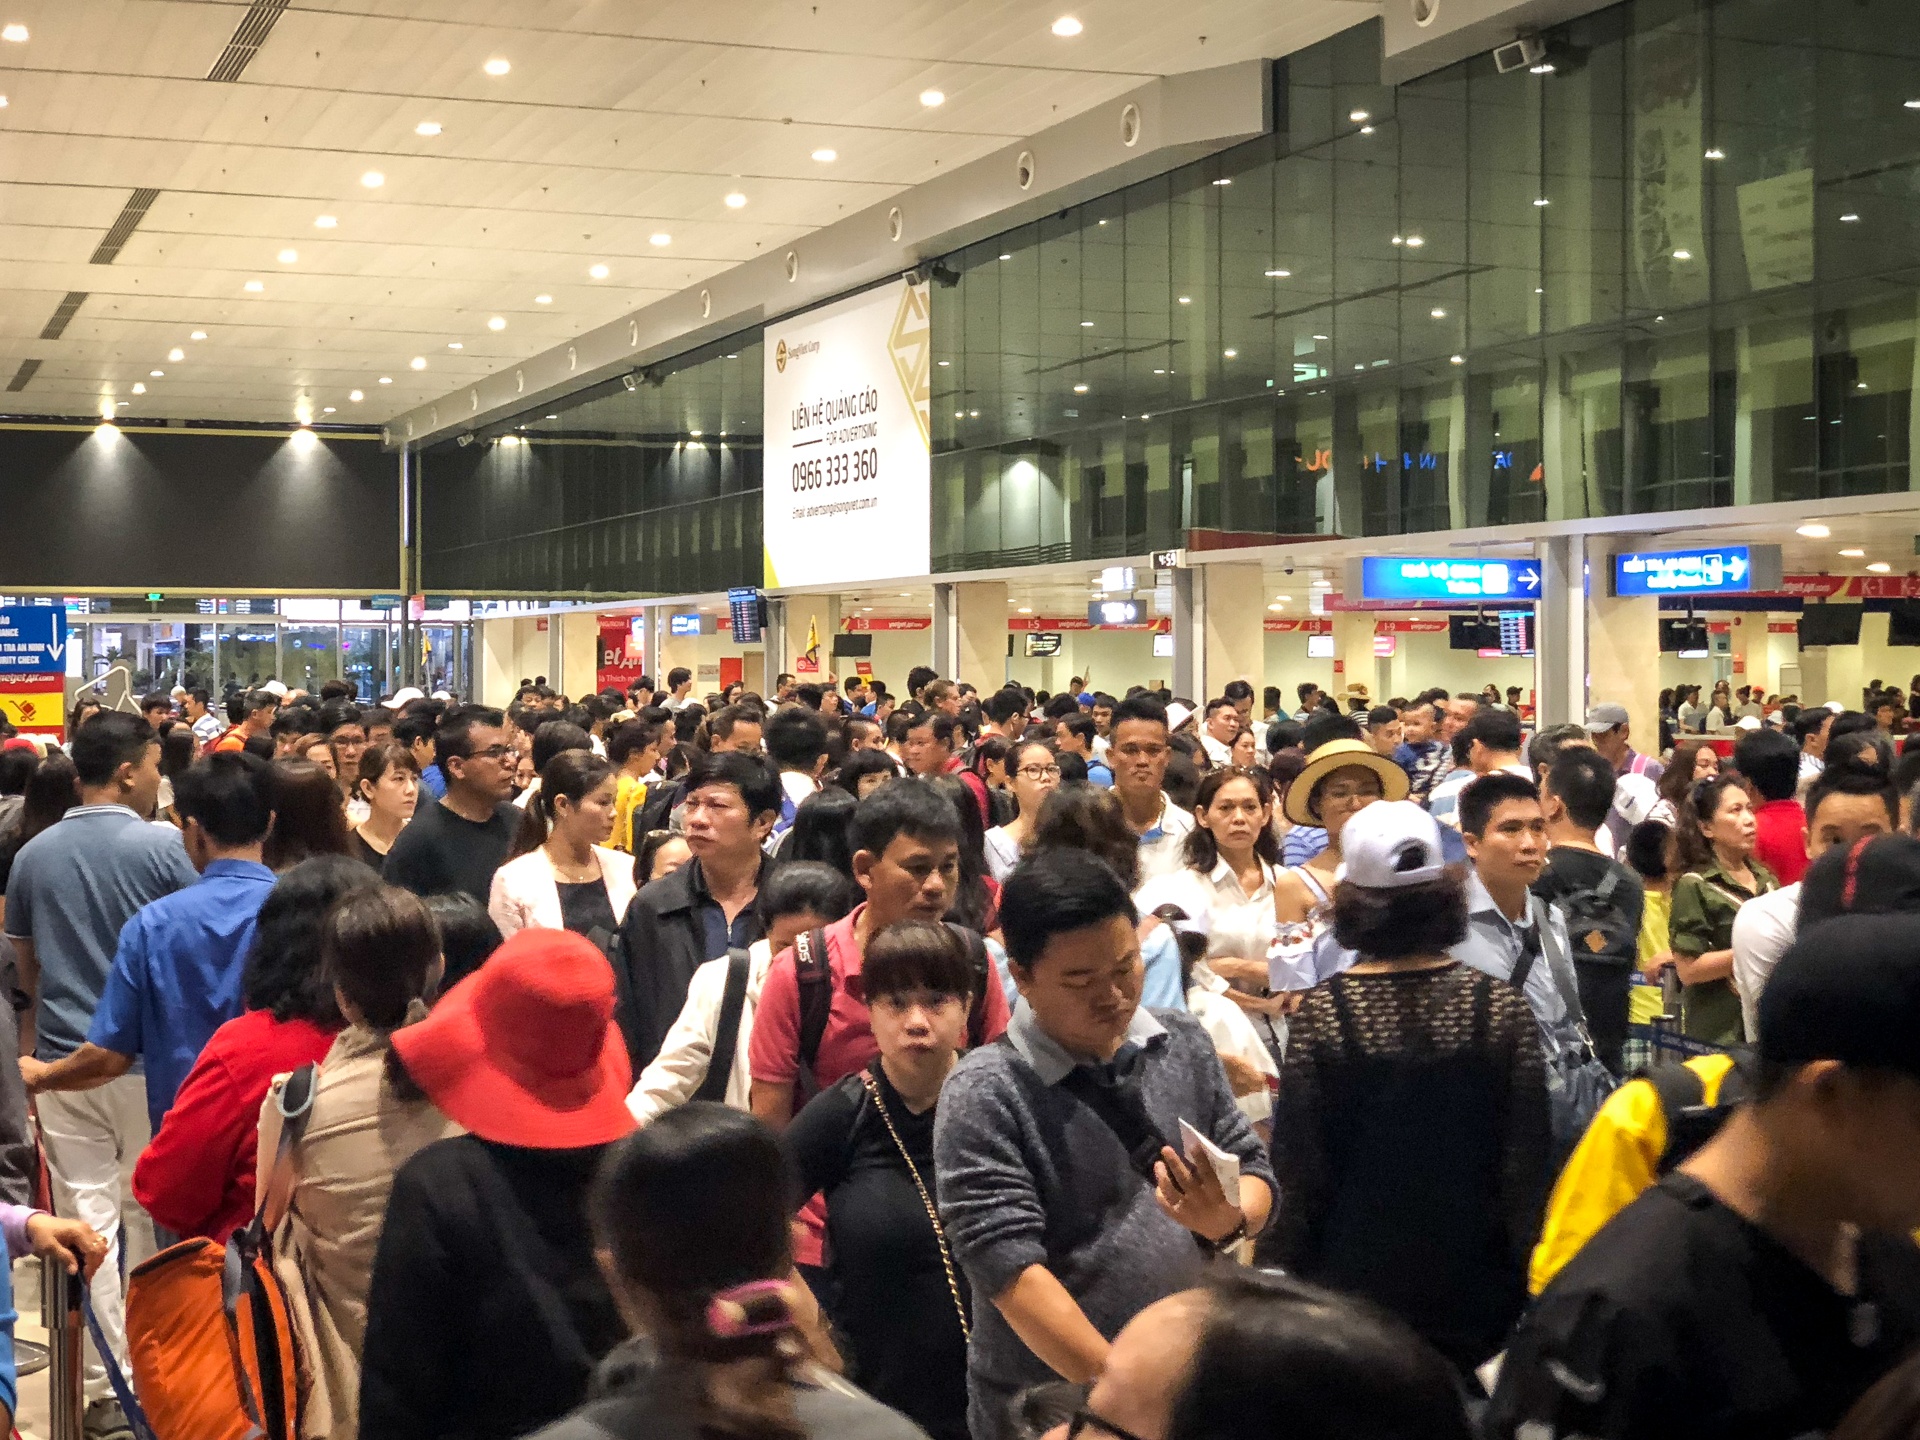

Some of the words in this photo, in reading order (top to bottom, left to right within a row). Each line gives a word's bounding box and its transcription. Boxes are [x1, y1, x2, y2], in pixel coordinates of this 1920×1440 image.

[792, 402, 810, 431] LIÊN
[825, 389, 857, 426] QUẢNG
[859, 384, 878, 415] CÁO
[826, 430, 838, 446] FOR
[839, 421, 877, 444] ADVERTISING
[792, 459, 822, 493] 0966
[826, 453, 849, 487] 333
[853, 447, 878, 482] 360
[18, 655, 40, 665] CHECK
